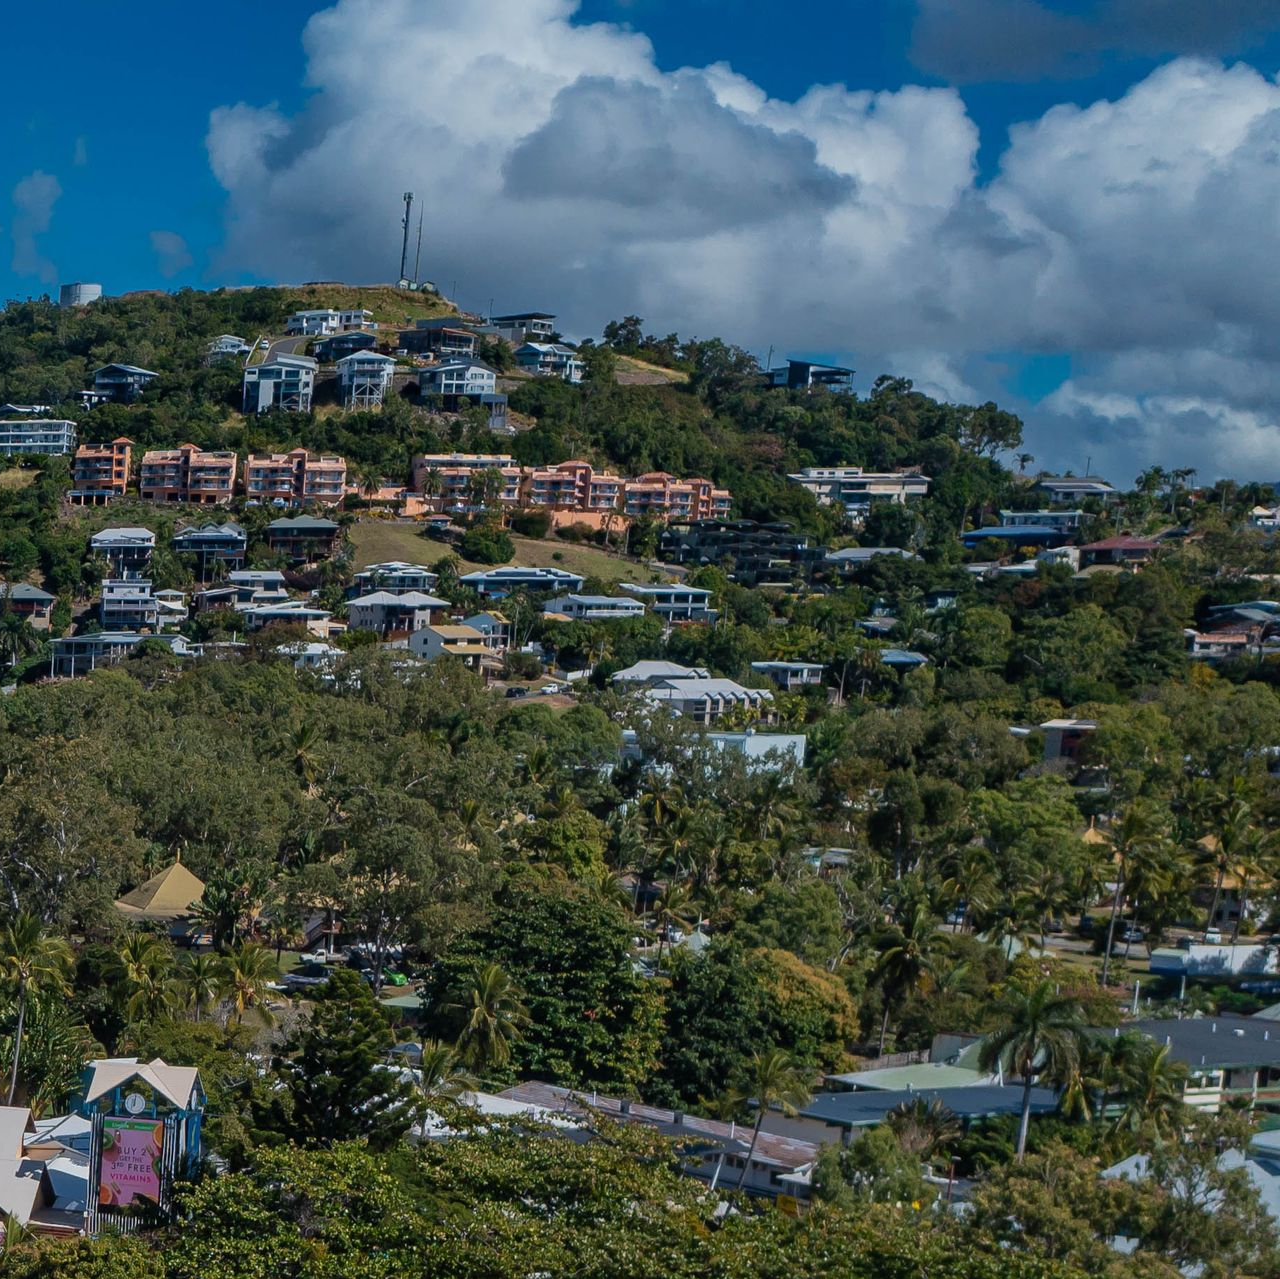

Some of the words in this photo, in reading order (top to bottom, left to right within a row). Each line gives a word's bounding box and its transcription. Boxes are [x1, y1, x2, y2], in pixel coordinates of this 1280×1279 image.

[117, 1146, 138, 1156] BUY
[127, 1163, 151, 1173] FREE
[110, 1173, 152, 1184] VITAMINS
